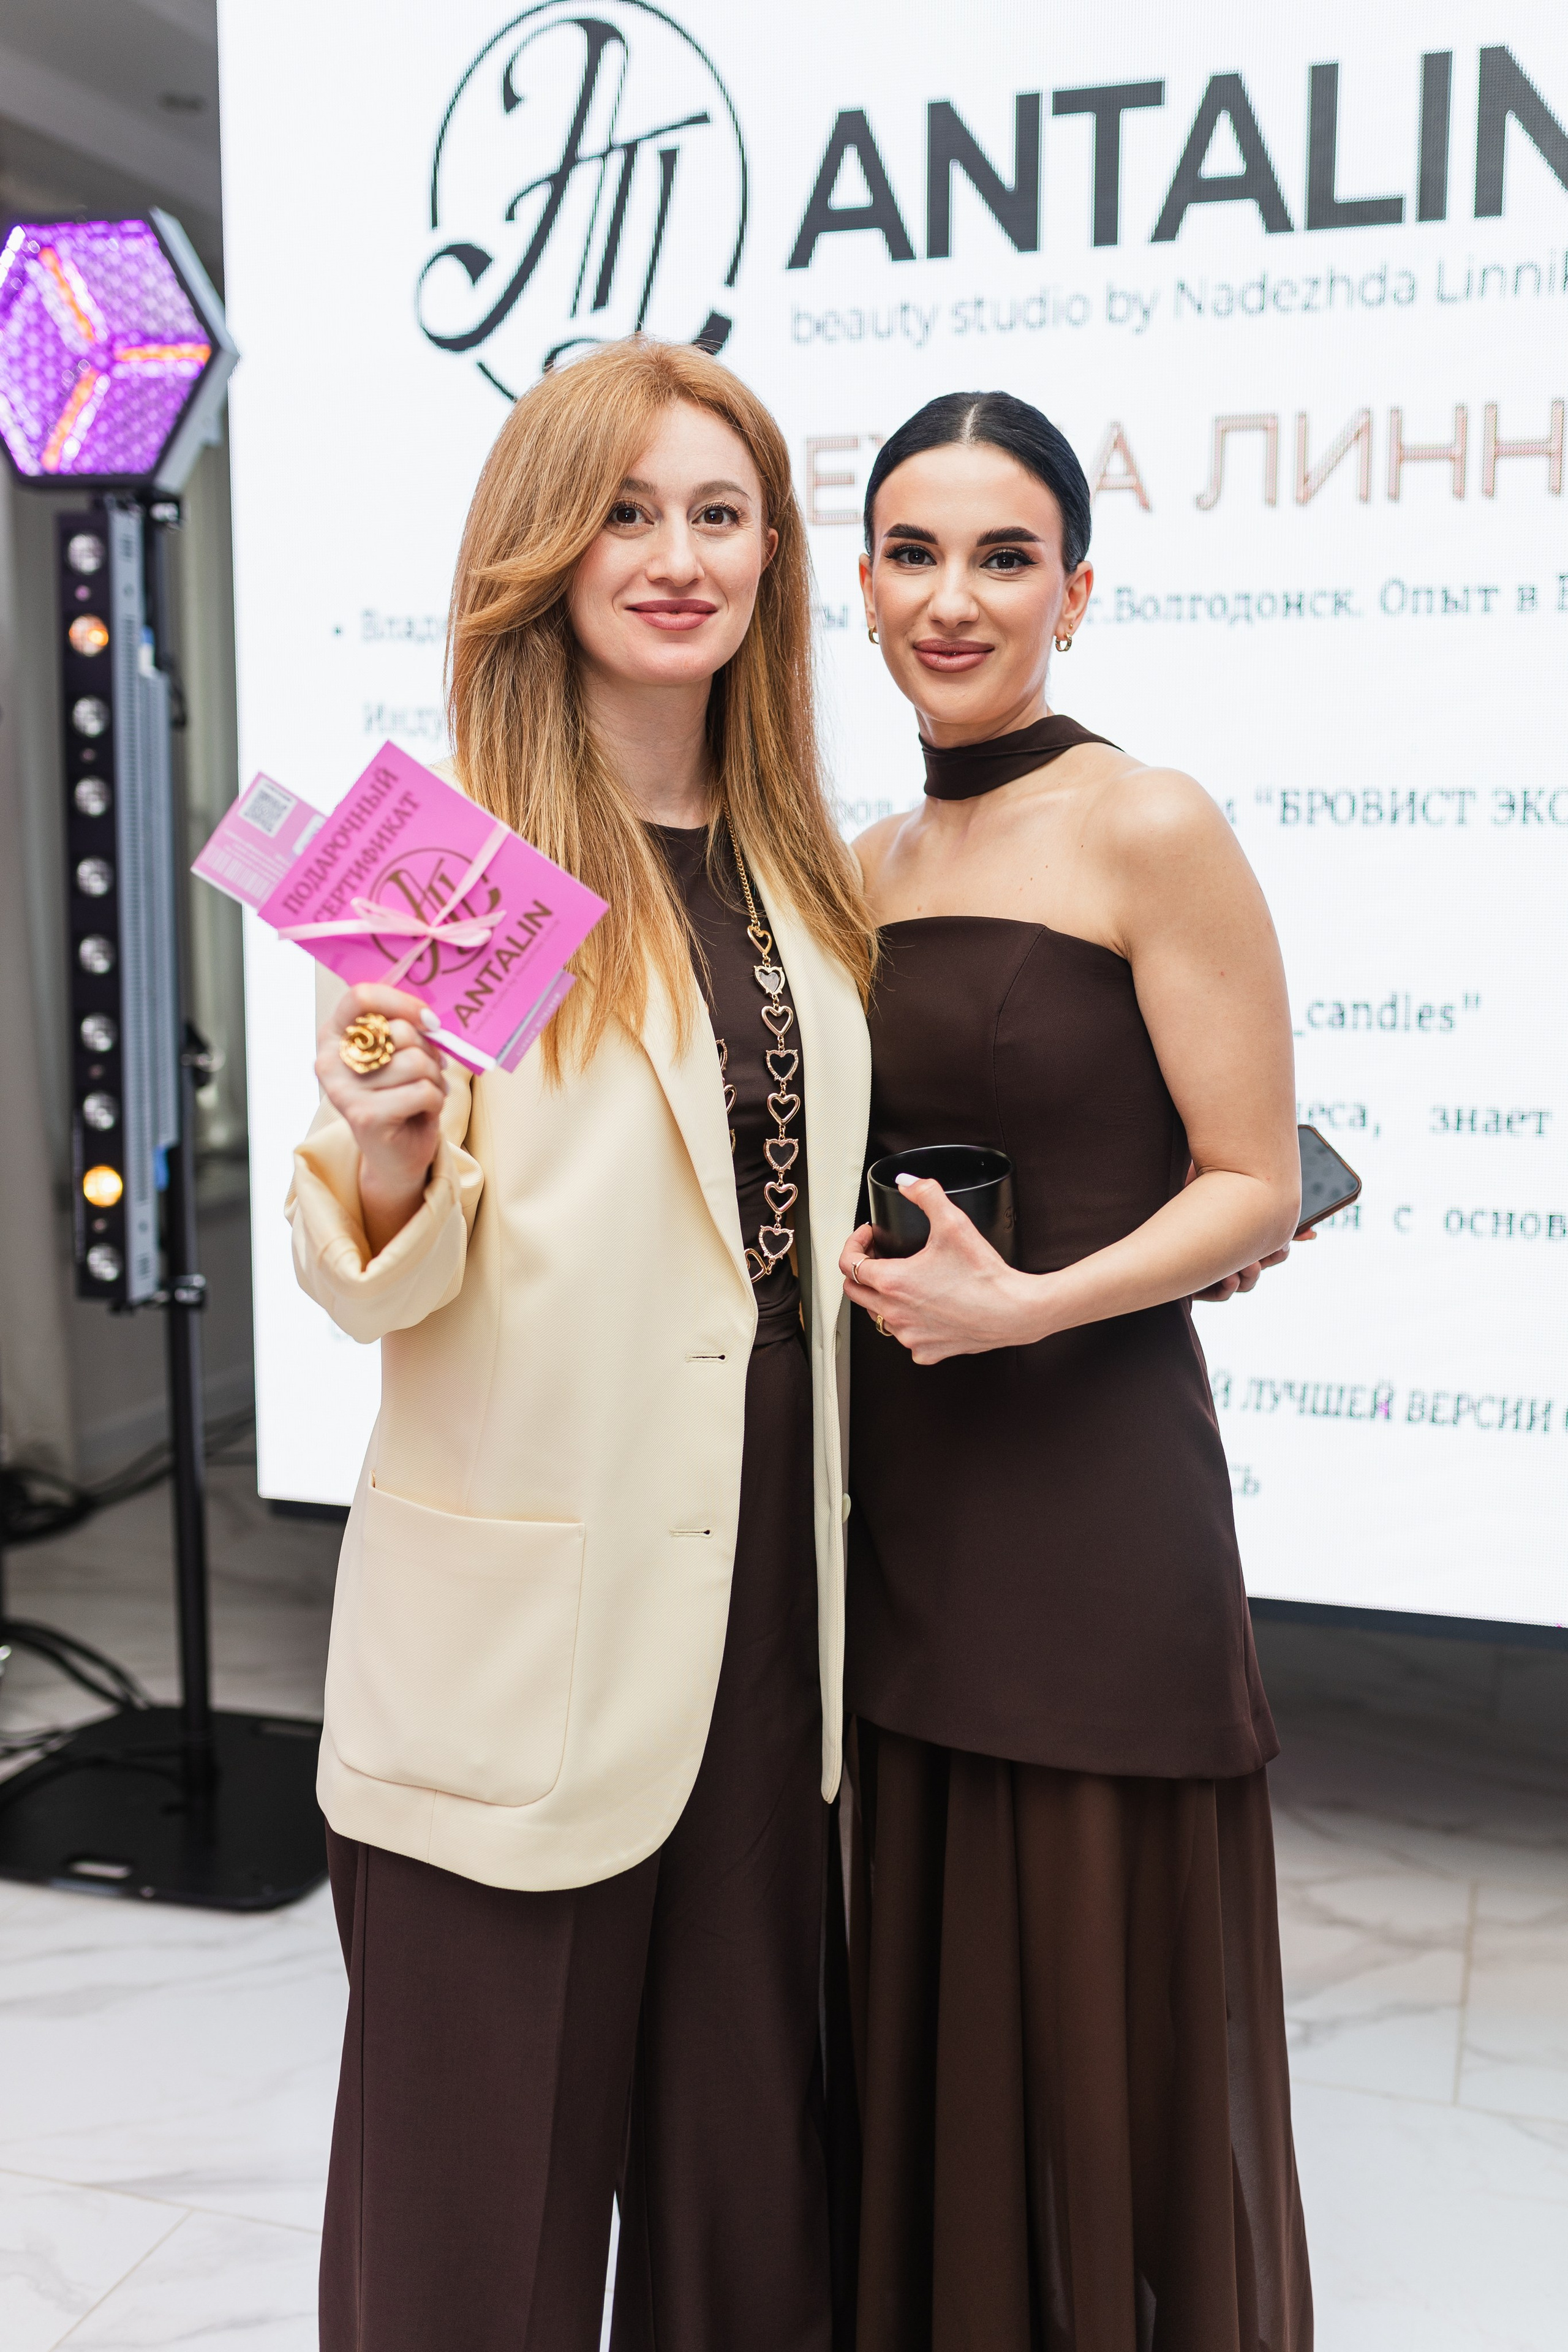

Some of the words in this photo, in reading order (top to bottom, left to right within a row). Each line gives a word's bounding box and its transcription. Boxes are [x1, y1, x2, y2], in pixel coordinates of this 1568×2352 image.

[786, 46, 1568, 270] ANTALIN
[791, 301, 938, 349] beauty
[951, 284, 1092, 335] studio
[1106, 281, 1159, 335] by
[1174, 262, 1417, 318] Nadezhda
[1437, 249, 1568, 304] Linni
[1195, 398, 1566, 510] ЛИНН
[1379, 577, 1499, 615] Опыт
[1517, 584, 1537, 614] в
[282, 767, 399, 914] ПОДАРОЧНЫЙ
[313, 791, 420, 922] СЕРТИФИКАТ
[454, 899, 553, 1028] ANTALIN
[1429, 1104, 1553, 1137] знает
[1241, 1377, 1395, 1422] ЛУЧШЕЙ
[1404, 1389, 1555, 1434] ВЕРСИИ
